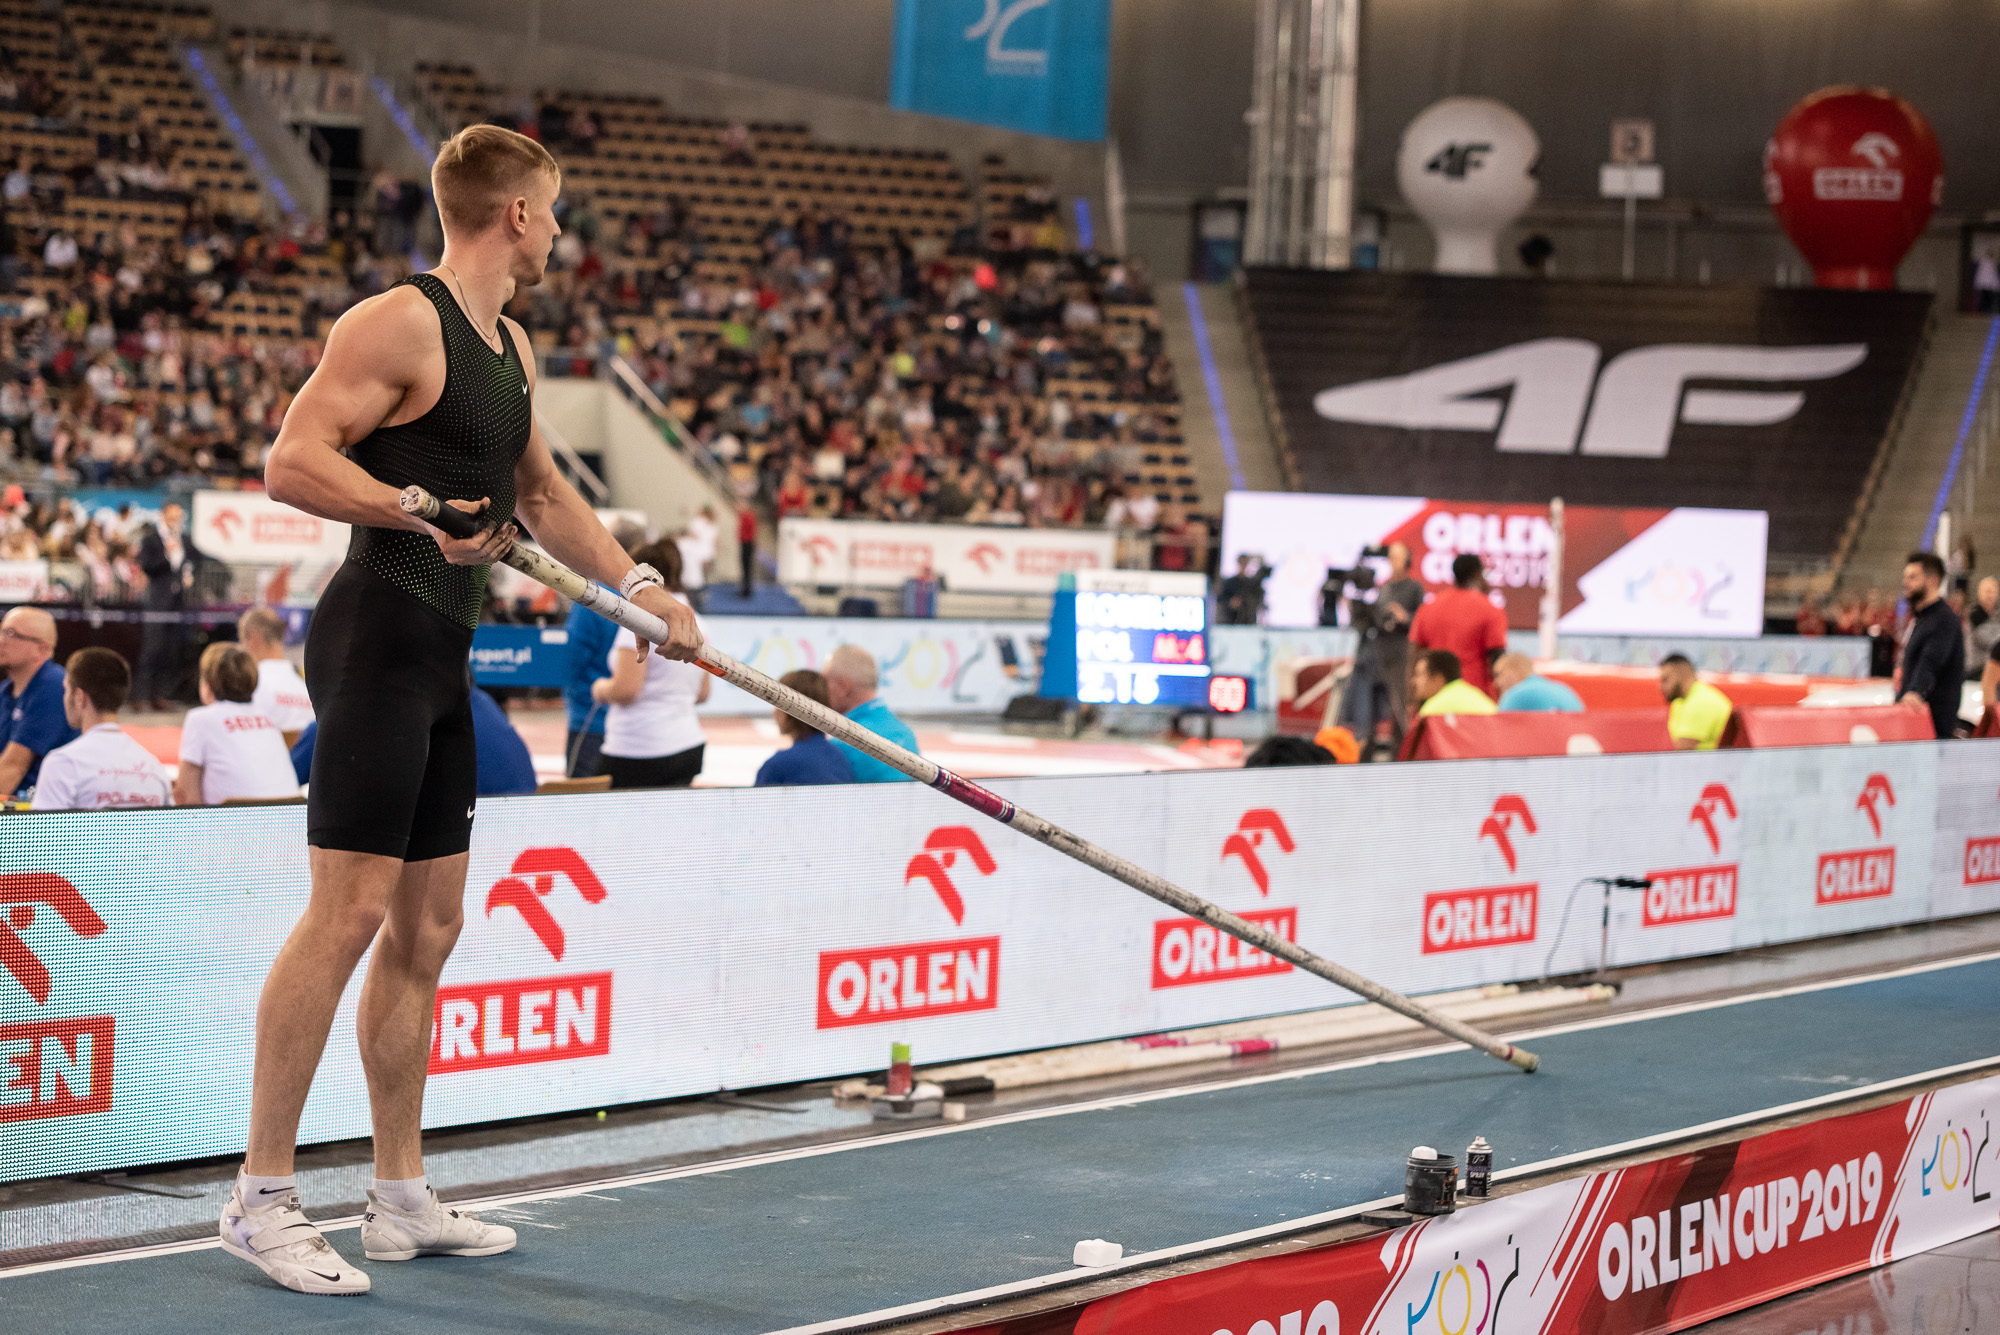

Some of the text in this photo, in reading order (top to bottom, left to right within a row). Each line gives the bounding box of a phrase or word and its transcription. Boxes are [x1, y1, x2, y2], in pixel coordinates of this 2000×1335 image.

[1314, 337, 1869, 458] 4F
[1648, 872, 1733, 920] ORLEN
[1821, 855, 1891, 898] ORLEN
[1428, 892, 1533, 947] ORLEN
[826, 948, 990, 1018] ORLEN
[431, 985, 599, 1062] RLEN
[1598, 1151, 1883, 1301] ORLEN CUP 2019
